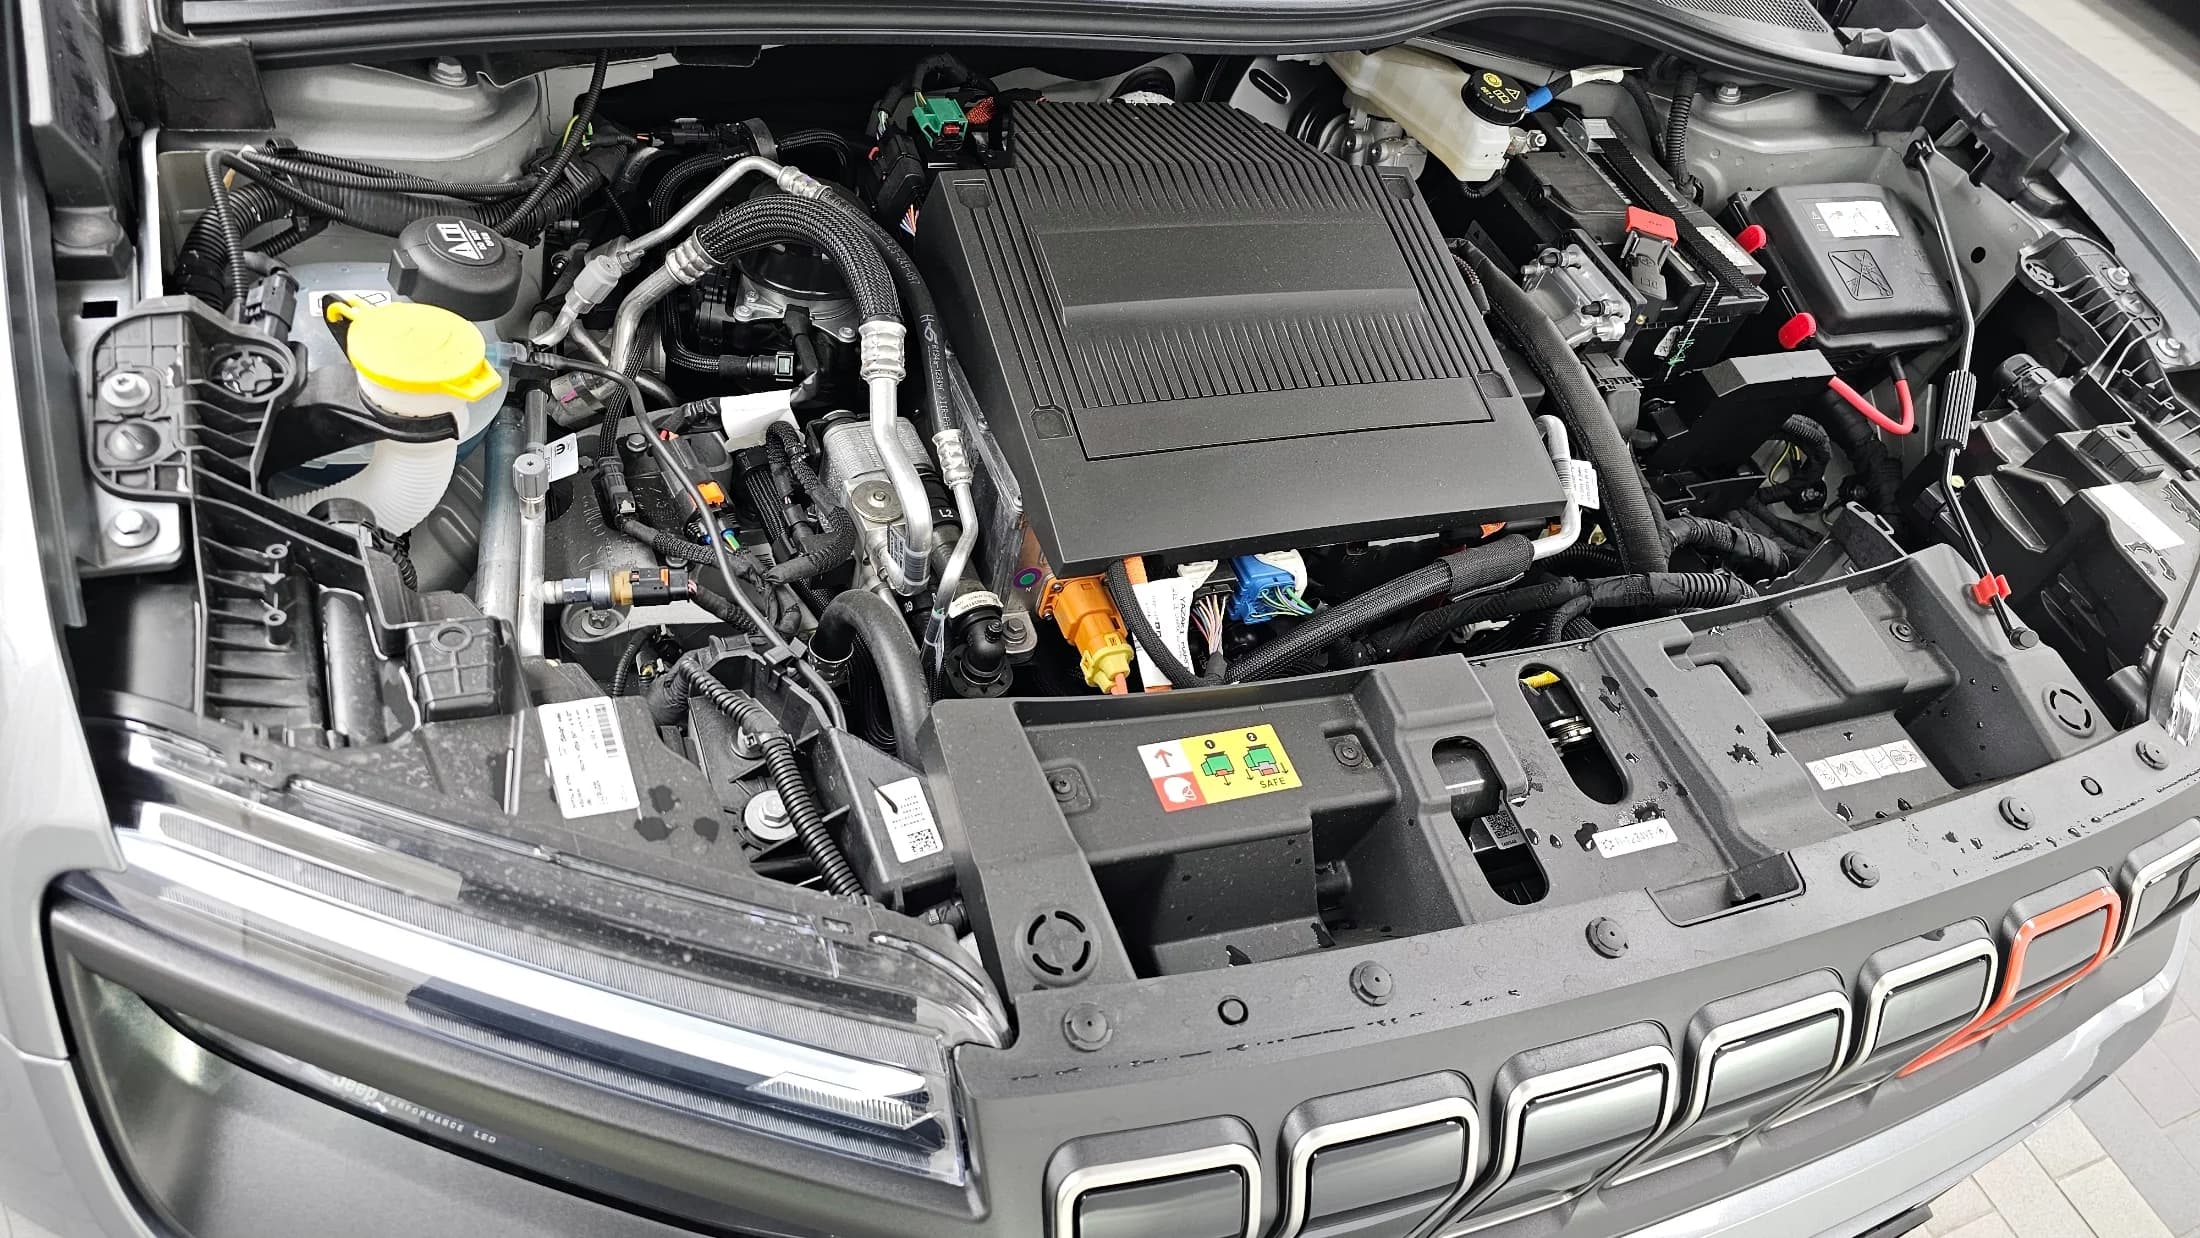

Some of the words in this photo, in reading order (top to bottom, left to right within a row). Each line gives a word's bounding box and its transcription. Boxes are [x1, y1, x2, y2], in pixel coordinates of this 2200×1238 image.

[1259, 777, 1286, 789] SAFE
[383, 1097, 465, 1132] PERFORMANCE
[473, 1130, 498, 1144] LED
